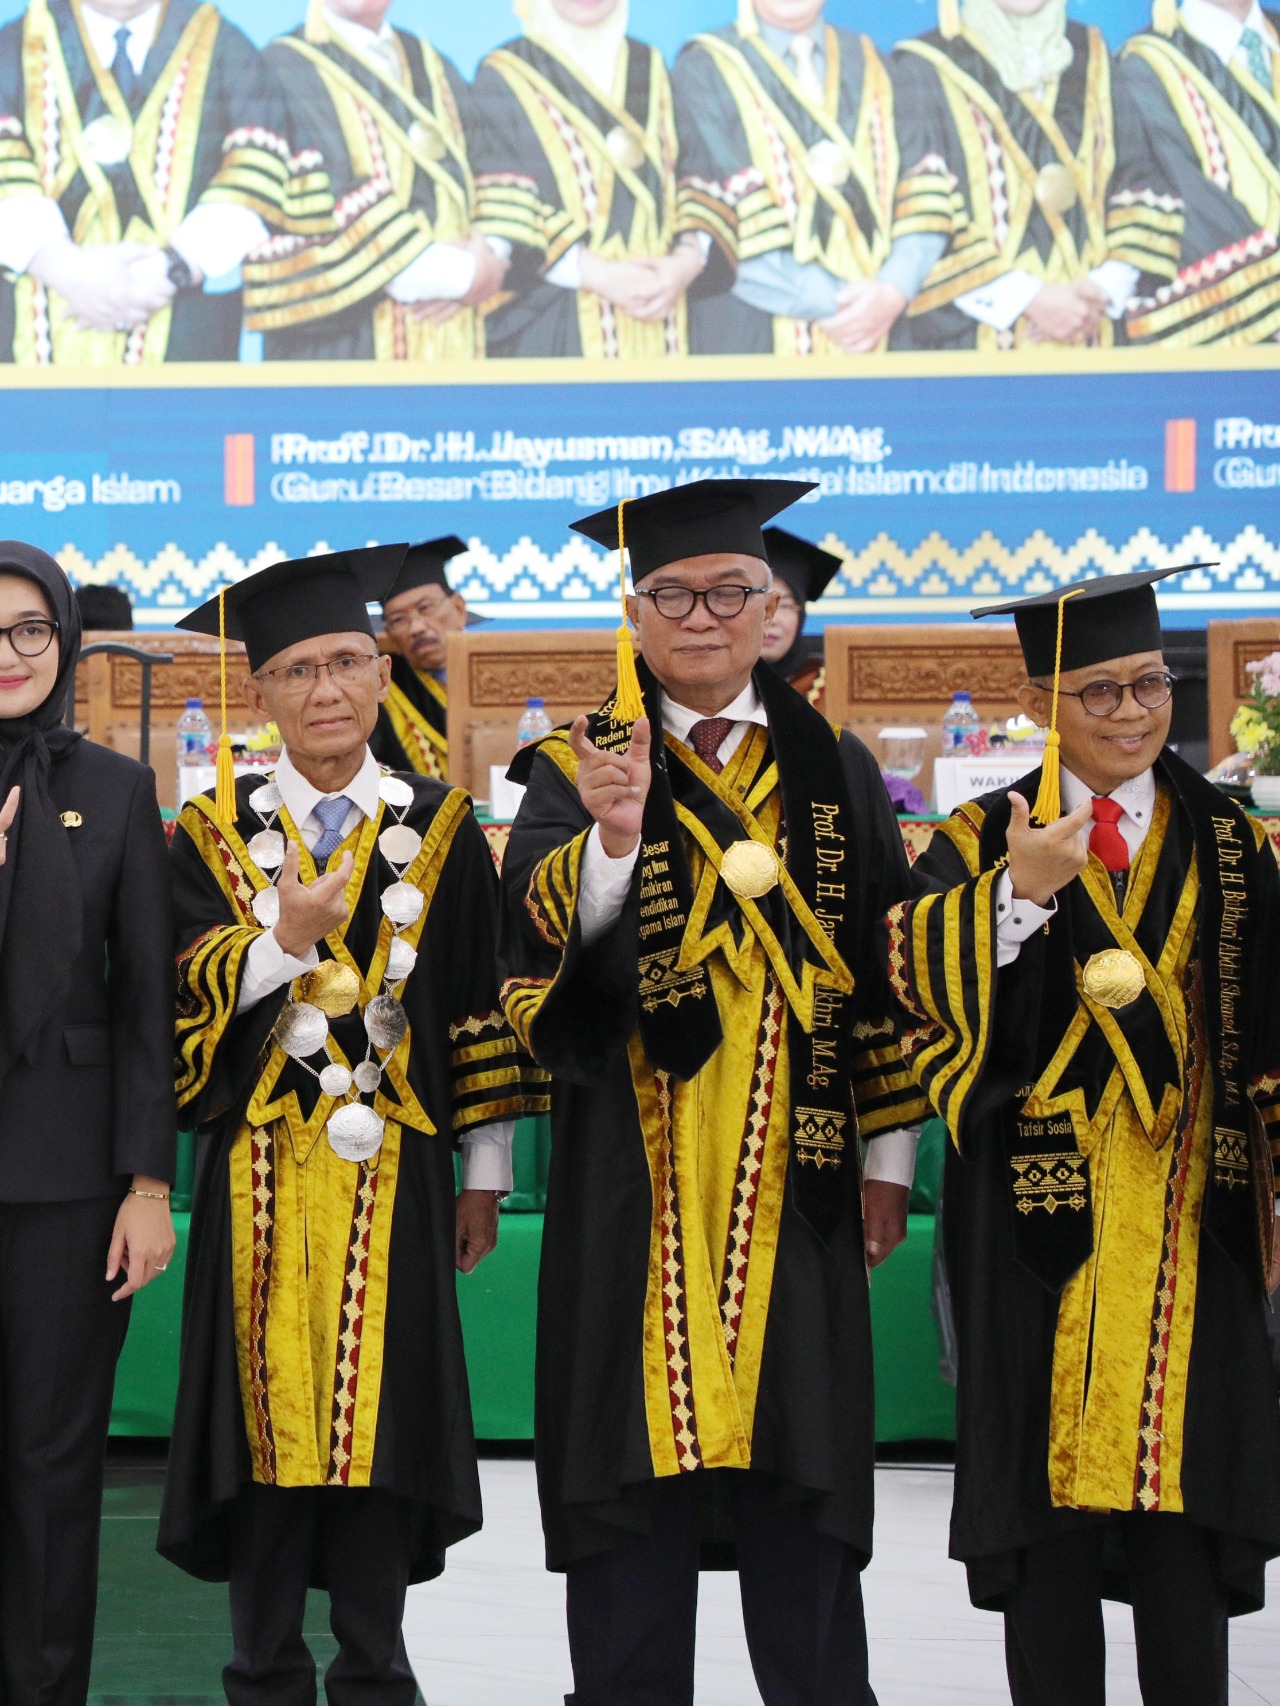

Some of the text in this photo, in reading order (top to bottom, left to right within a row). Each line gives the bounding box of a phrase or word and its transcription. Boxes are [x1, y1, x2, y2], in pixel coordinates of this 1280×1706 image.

[92, 472, 182, 504] Islam
[595, 730, 624, 748] Raden
[811, 801, 846, 841] Prof.
[1211, 816, 1243, 844] Prof.
[642, 840, 670, 858] Besar
[1218, 847, 1243, 867] Dr.
[652, 859, 670, 875] Ilmu
[816, 847, 845, 875] Dr.
[1220, 871, 1246, 886] H.
[640, 879, 674, 900] mikiran
[816, 881, 846, 902] H.
[640, 896, 679, 918] endidikan
[1220, 889, 1249, 941] Bukhori
[638, 912, 686, 941] gama Islam
[1219, 941, 1243, 980] Abdul
[1017, 1118, 1073, 1137] Tafsir Sosia
